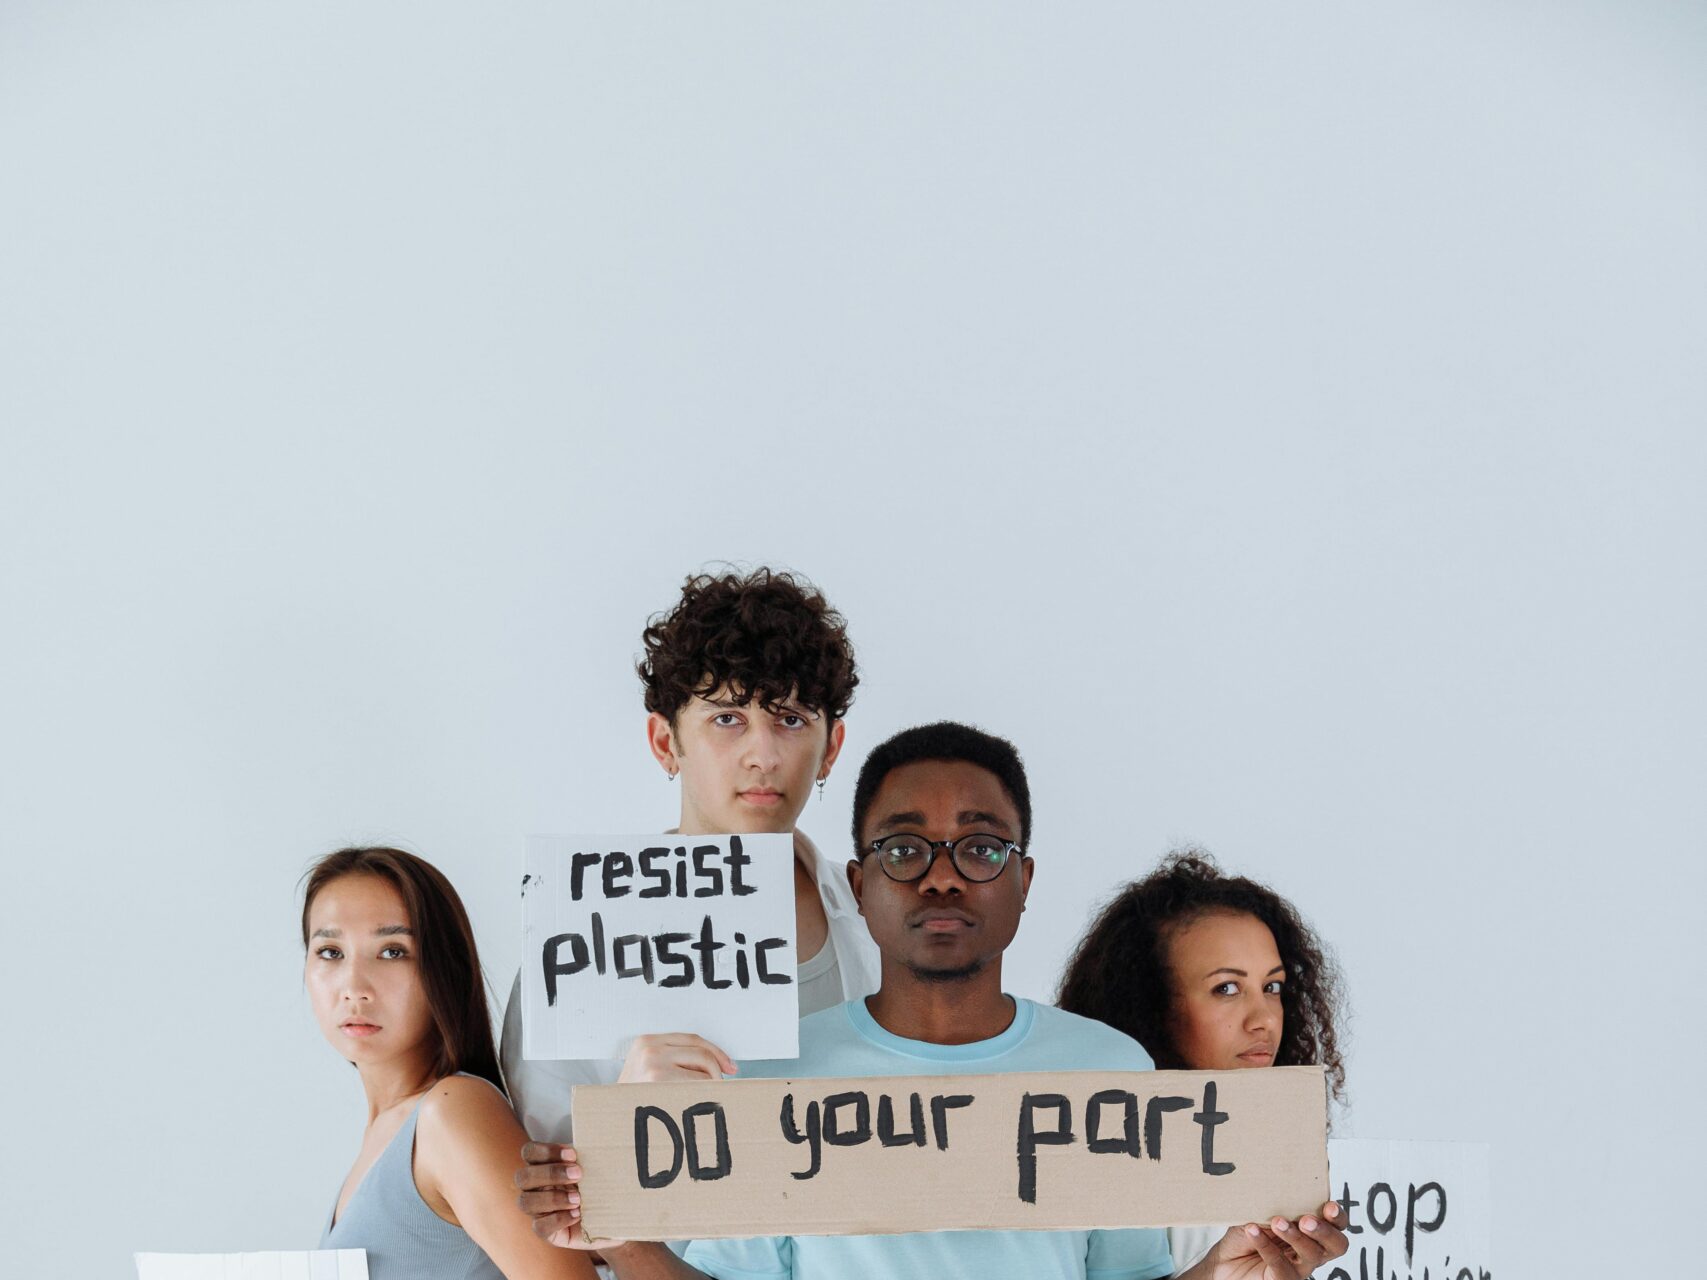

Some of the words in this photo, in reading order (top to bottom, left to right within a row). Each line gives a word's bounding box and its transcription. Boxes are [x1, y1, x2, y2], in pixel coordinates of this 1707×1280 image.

[570, 834, 759, 902] resist
[542, 911, 793, 1007] plastic
[779, 1090, 976, 1181] your
[1016, 1080, 1238, 1206] part
[1336, 1181, 1448, 1269] top
